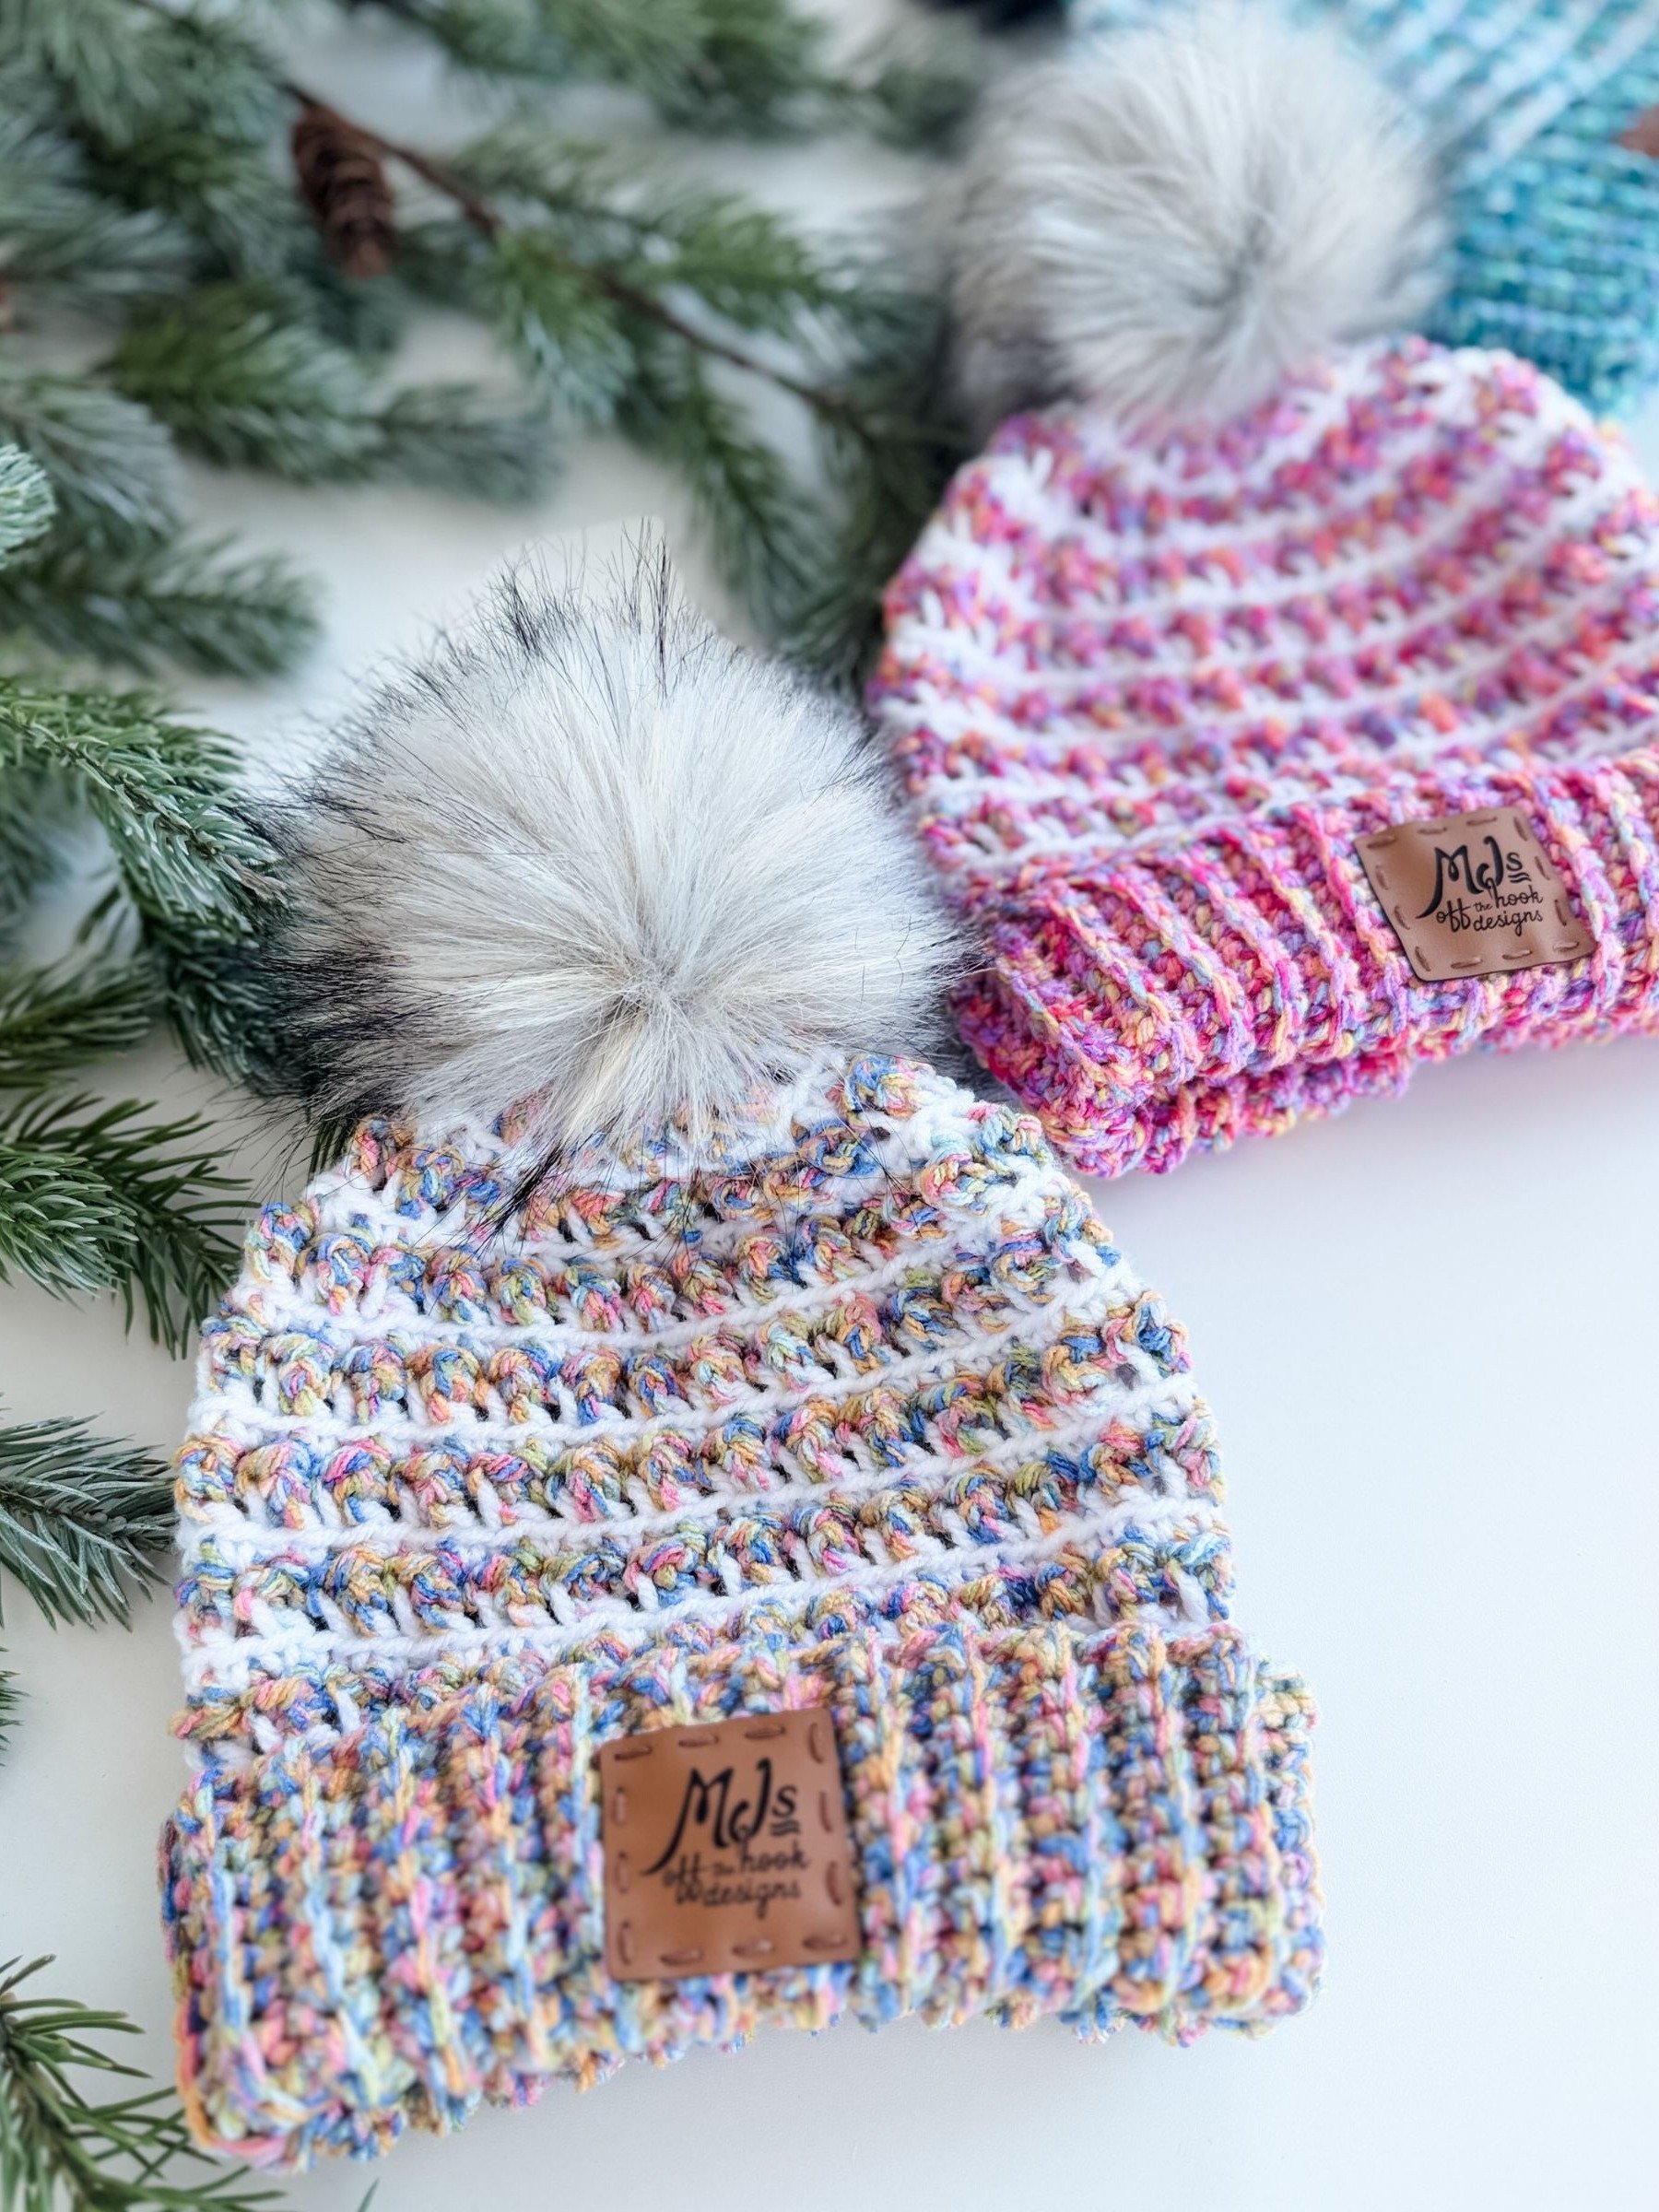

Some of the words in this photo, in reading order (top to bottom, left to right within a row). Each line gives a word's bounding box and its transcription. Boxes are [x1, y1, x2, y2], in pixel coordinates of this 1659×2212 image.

[1436, 898, 1471, 933] off
[1473, 902, 1492, 912] the
[1493, 884, 1544, 909] hook
[1473, 910, 1543, 936] designs
[741, 1842, 806, 1873] hook
[702, 1880, 801, 1921] designs
